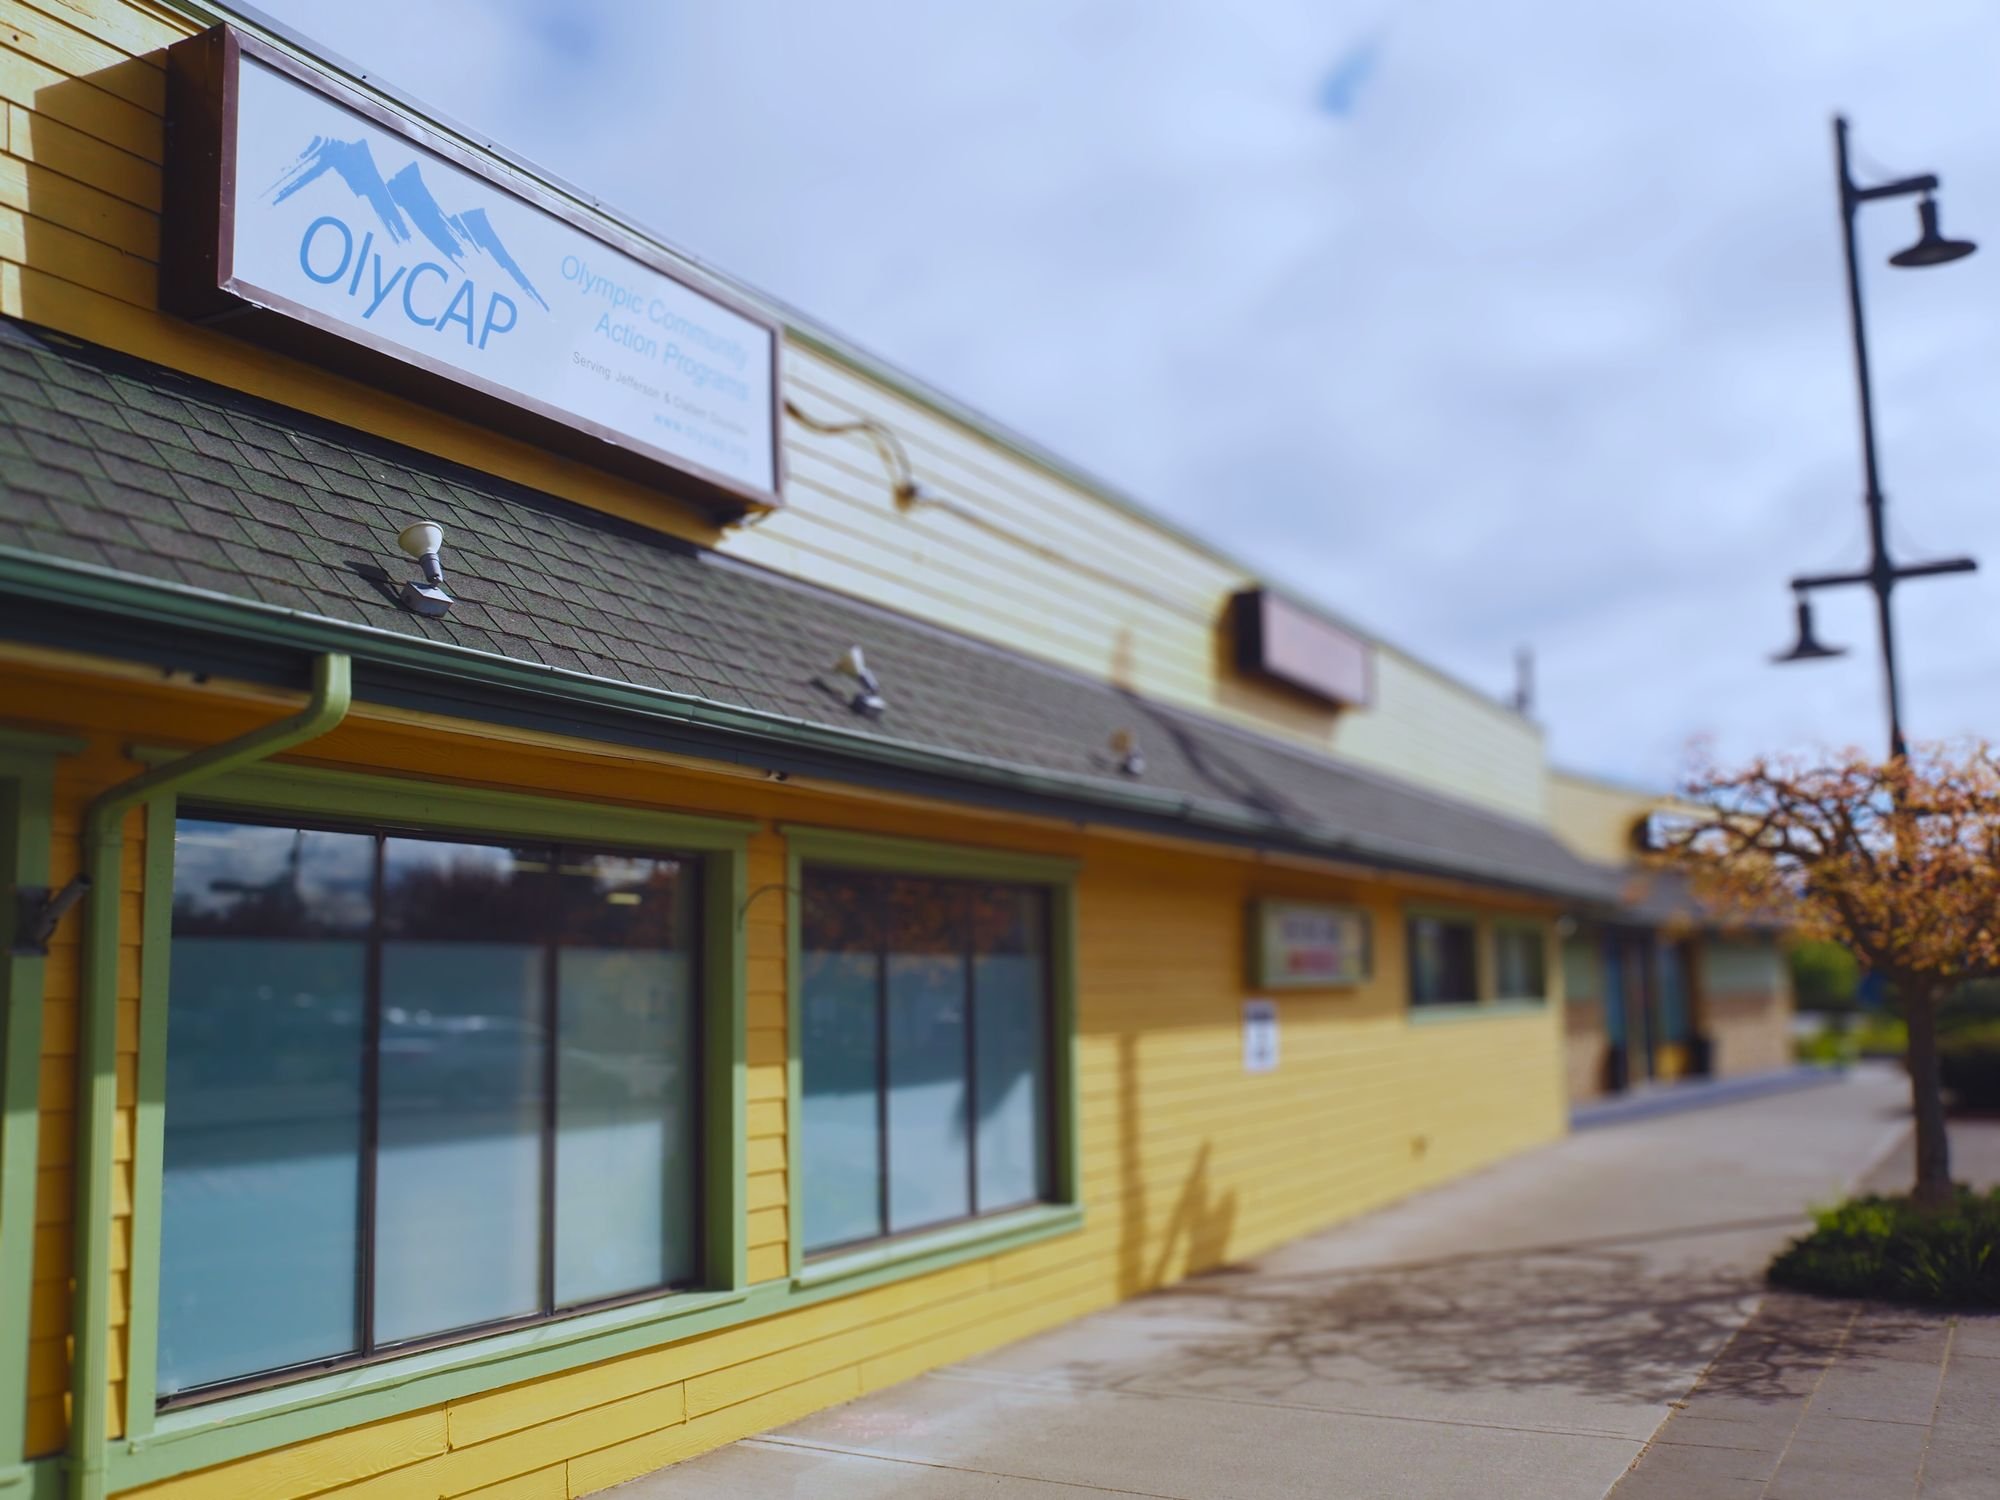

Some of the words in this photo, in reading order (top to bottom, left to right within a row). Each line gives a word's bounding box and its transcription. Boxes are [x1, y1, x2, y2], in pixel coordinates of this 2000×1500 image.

[300, 216, 517, 350] OlyCAP
[561, 255, 643, 308] Olympic
[594, 312, 657, 359] Action
[572, 351, 612, 381] Serving
